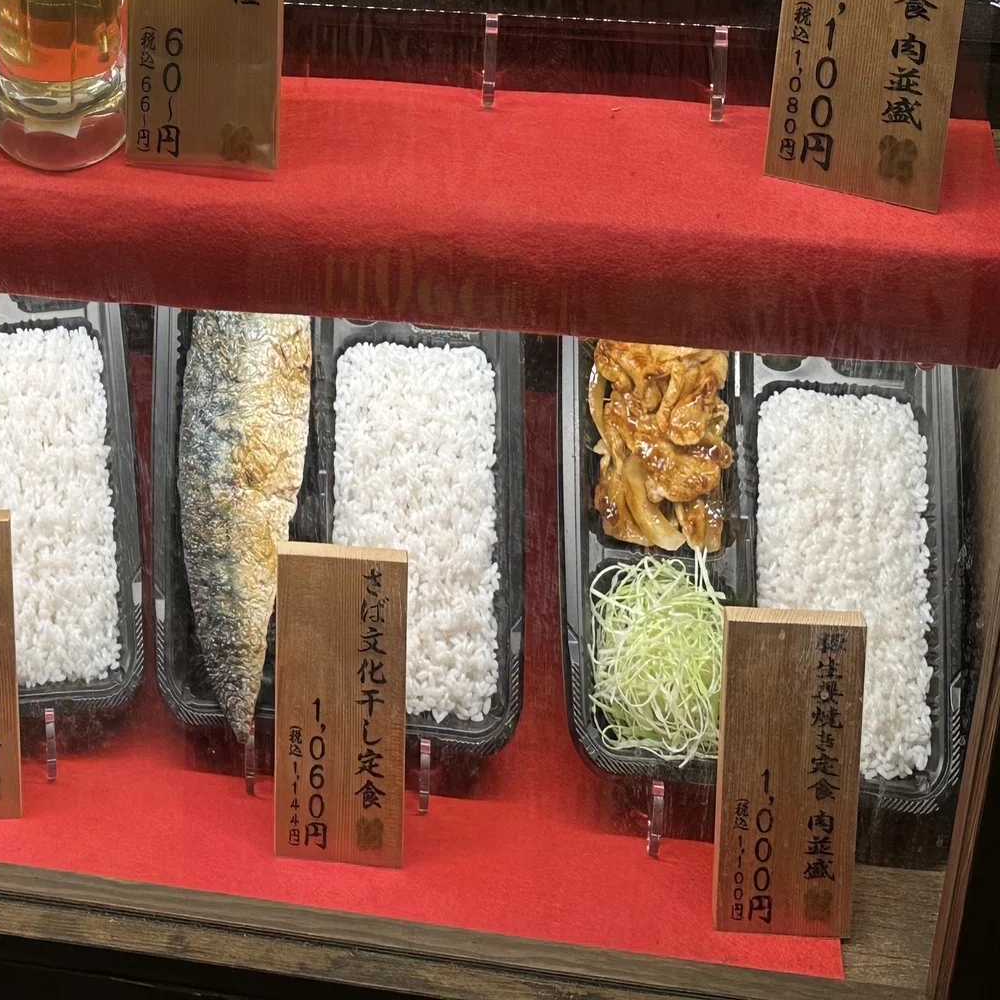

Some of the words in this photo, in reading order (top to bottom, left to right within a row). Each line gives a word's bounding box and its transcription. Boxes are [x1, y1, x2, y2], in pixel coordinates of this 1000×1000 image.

[354, 568, 390, 811] さば文化干し定食
[304, 697, 328, 851] 1,060円
[747, 768, 775, 924] 1,000円
